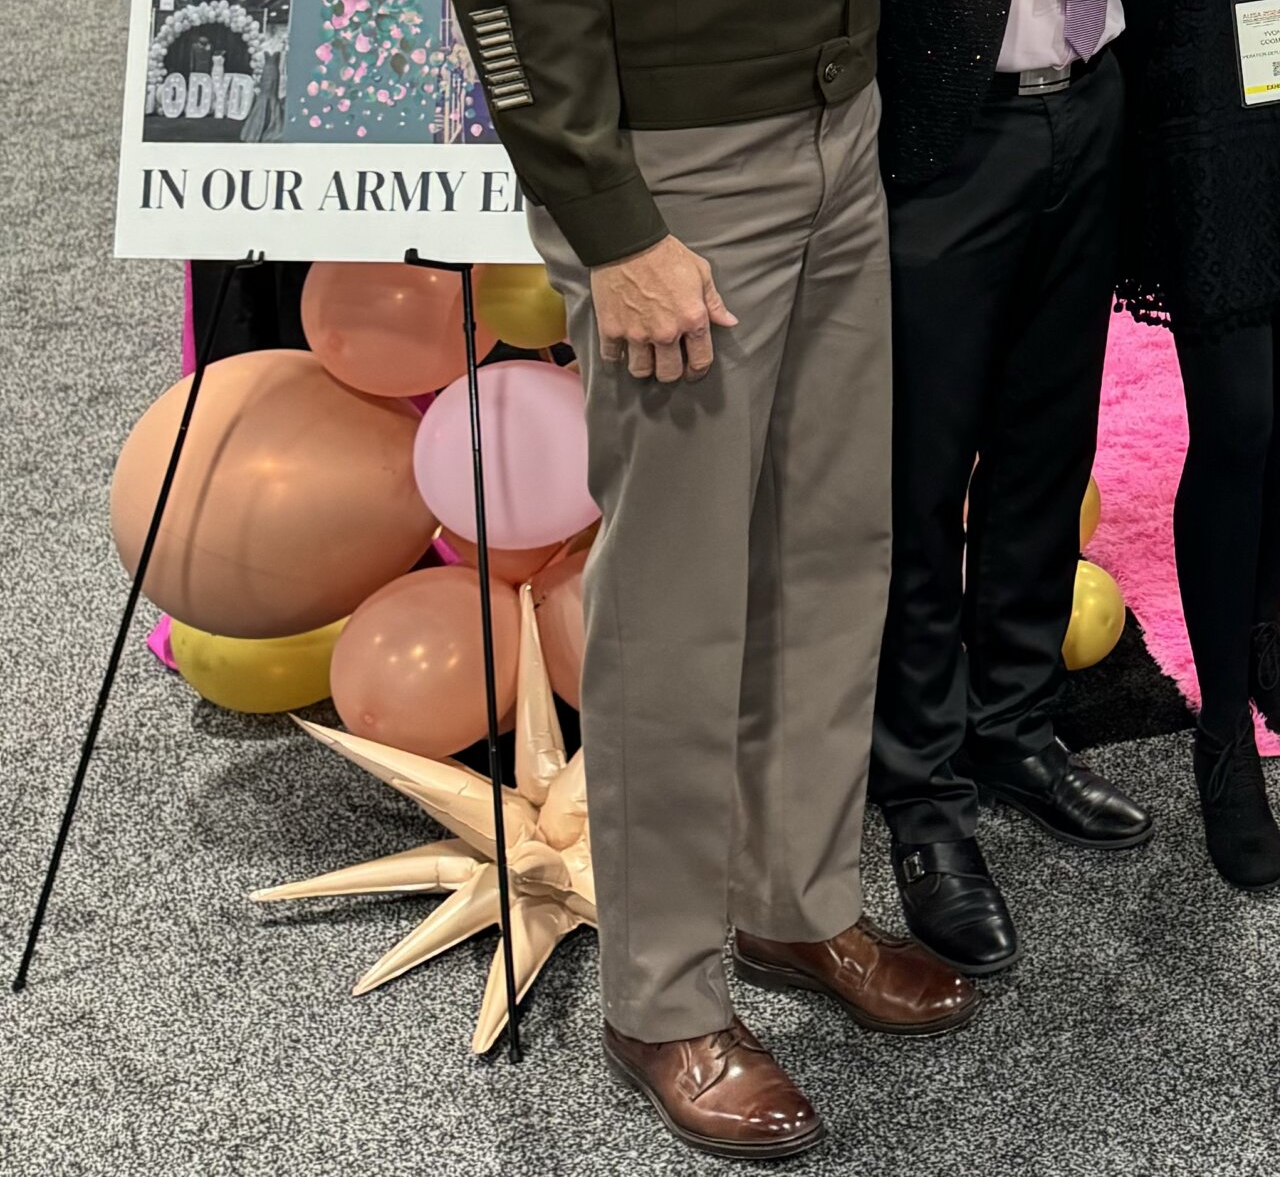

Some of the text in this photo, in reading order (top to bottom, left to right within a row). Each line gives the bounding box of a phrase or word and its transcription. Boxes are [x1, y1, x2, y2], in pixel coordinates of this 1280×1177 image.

[139, 168, 528, 212] IN OUR ARMY E
